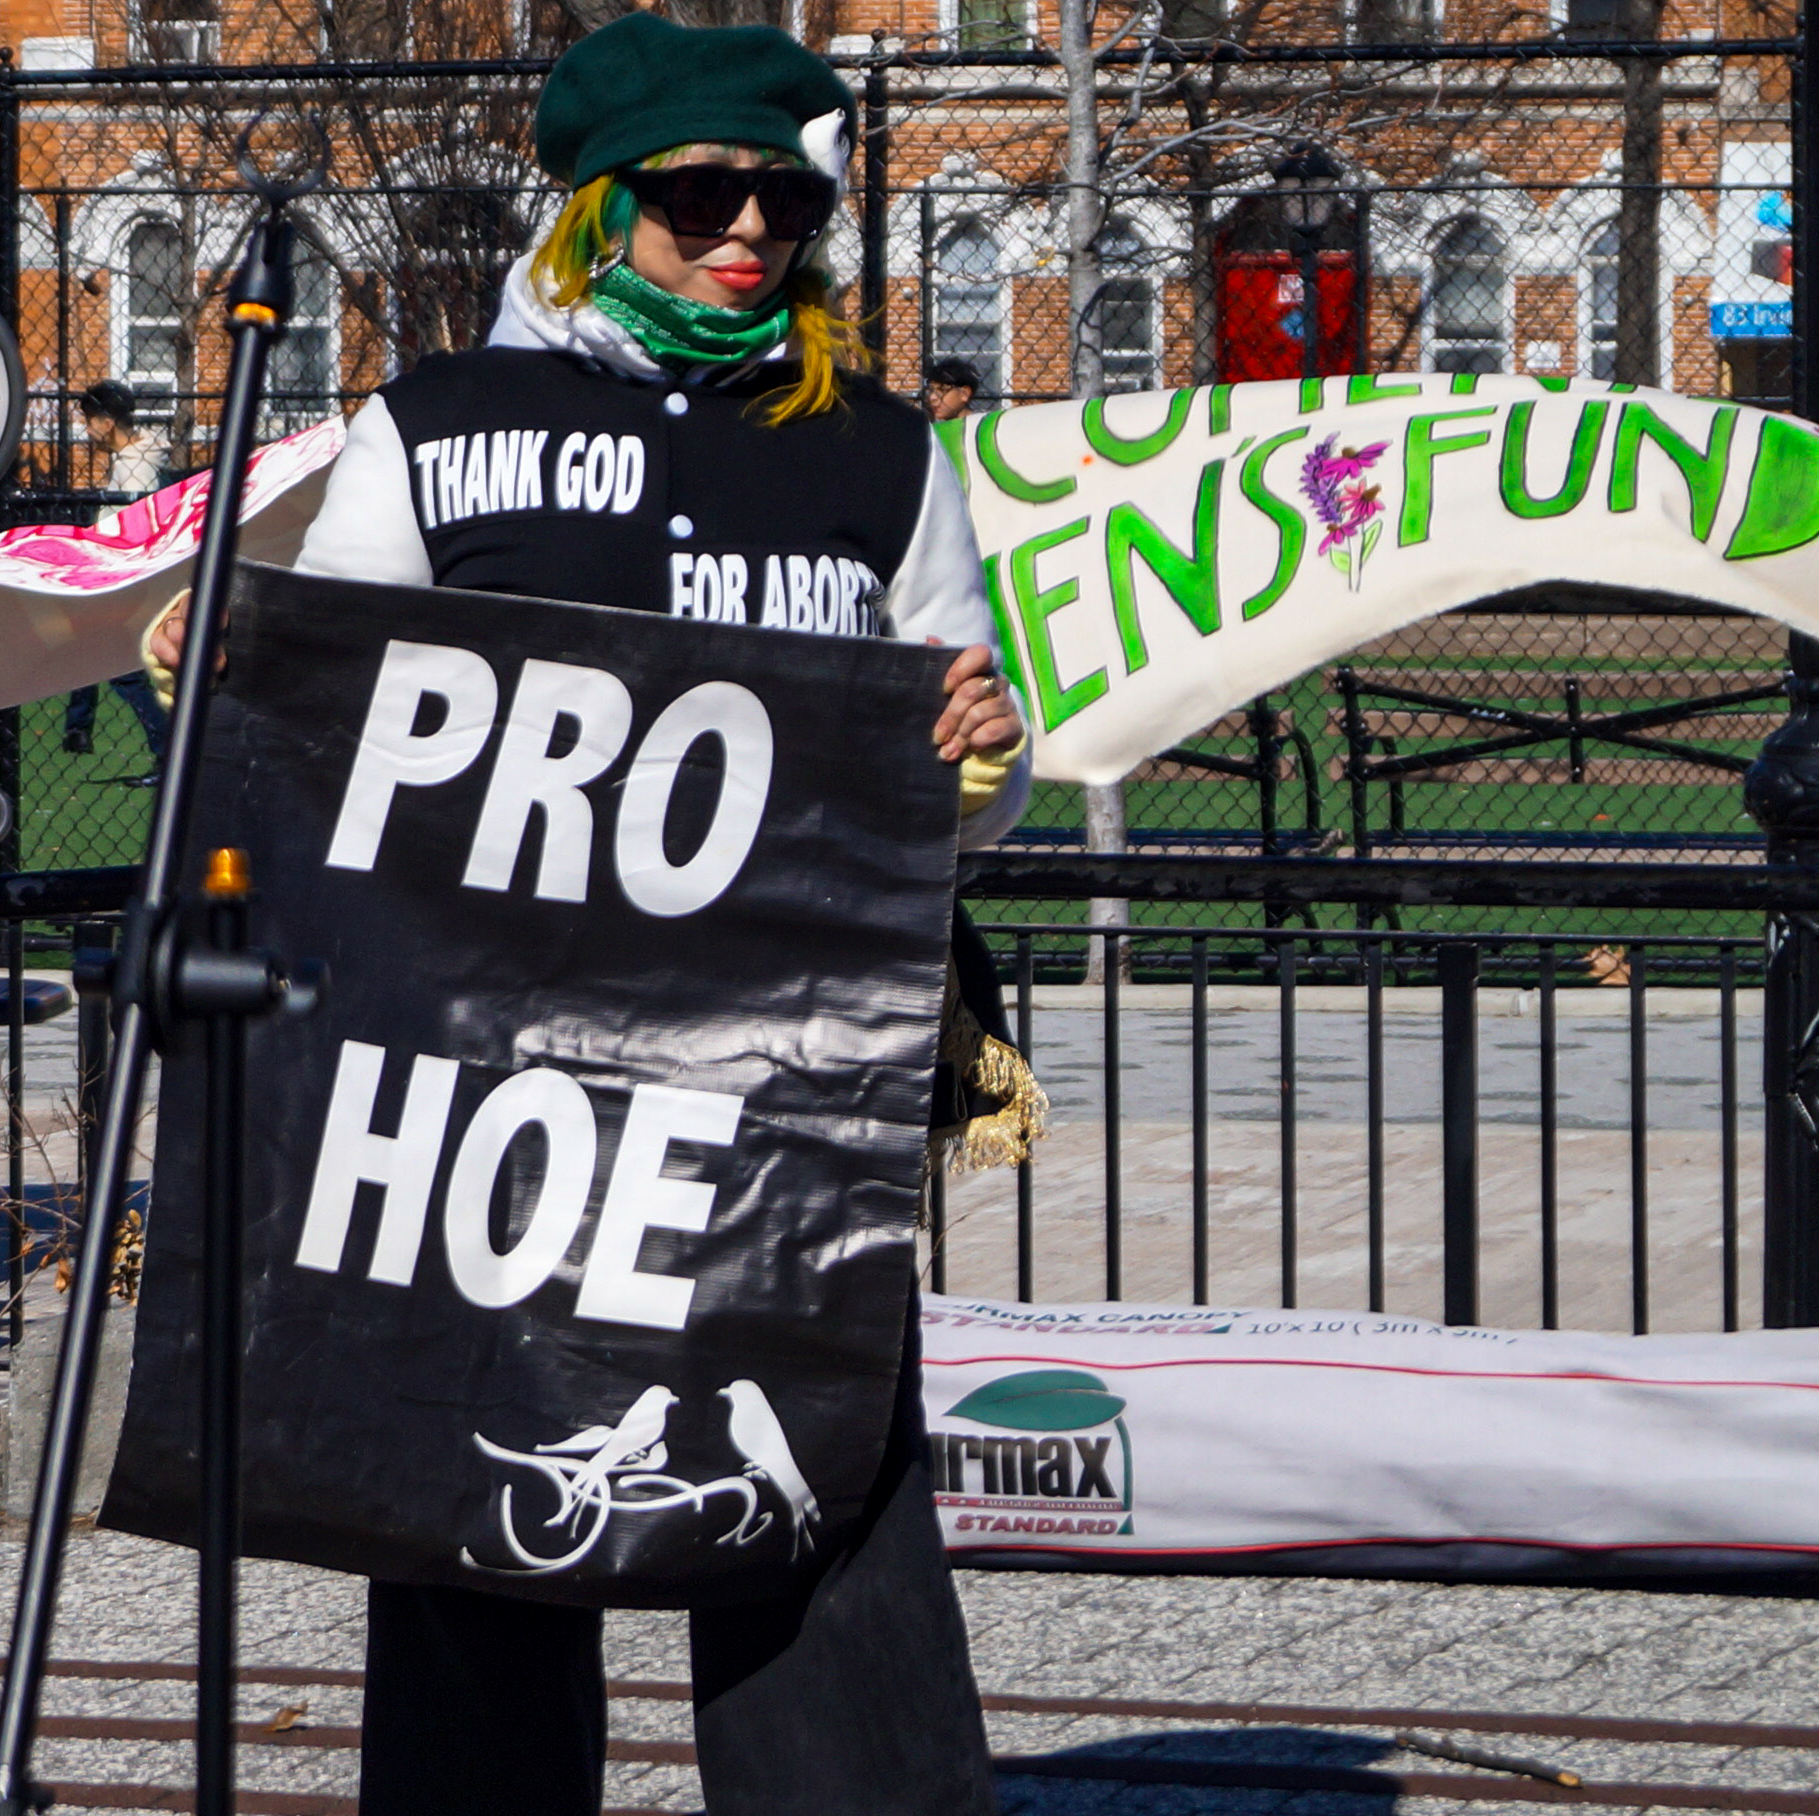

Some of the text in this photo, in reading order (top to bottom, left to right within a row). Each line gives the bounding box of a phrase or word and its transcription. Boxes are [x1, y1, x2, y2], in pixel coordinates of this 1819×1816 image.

[415, 430, 646, 530] THANK GOD
[671, 553, 884, 637] FOR ABORT
[983, 425, 1311, 735] EN'S
[1398, 400, 1819, 561] FUND
[325, 639, 774, 917] PRO
[294, 1039, 745, 1330] HOE
[1097, 1310, 1253, 1324] CANOPY
[954, 1512, 1119, 1535] STANDARD
